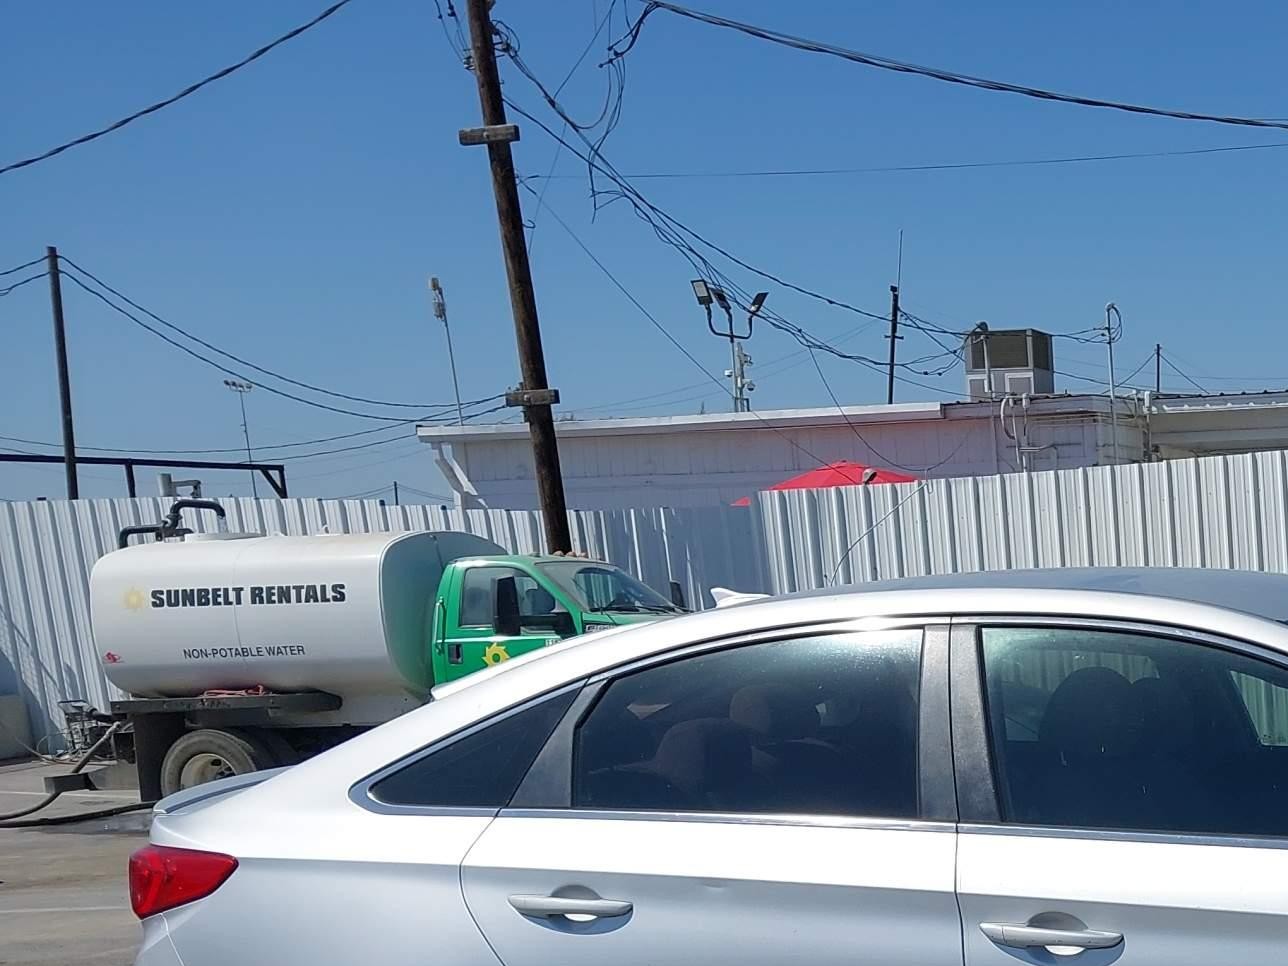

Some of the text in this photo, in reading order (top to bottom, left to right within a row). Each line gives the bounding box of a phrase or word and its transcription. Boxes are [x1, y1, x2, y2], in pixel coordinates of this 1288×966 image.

[151, 583, 346, 608] SUNBELT RENTALS
[183, 645, 306, 660] NON-POTABLE WATER
